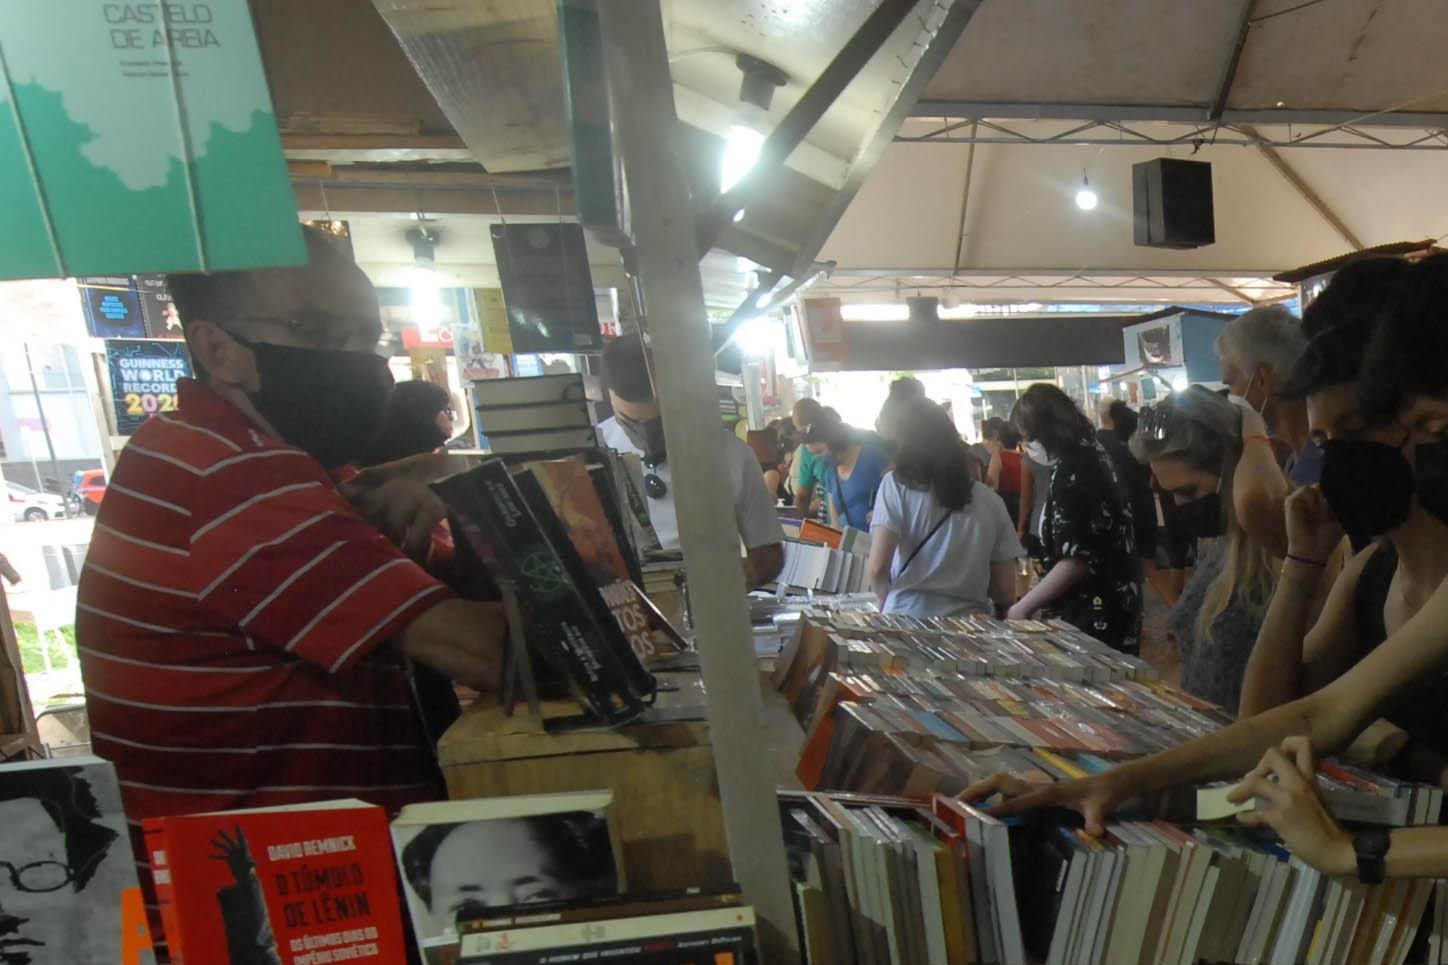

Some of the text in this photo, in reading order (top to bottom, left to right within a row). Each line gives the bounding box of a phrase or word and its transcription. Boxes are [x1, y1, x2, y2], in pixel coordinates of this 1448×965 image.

[120, 358, 184, 369] GUINNESS
[120, 368, 185, 382] WORLD
[123, 382, 178, 394] RECORD
[125, 393, 178, 416] 202
[267, 835, 356, 861] DAVID REMNICK
[284, 891, 372, 928] DE LÊNIN
